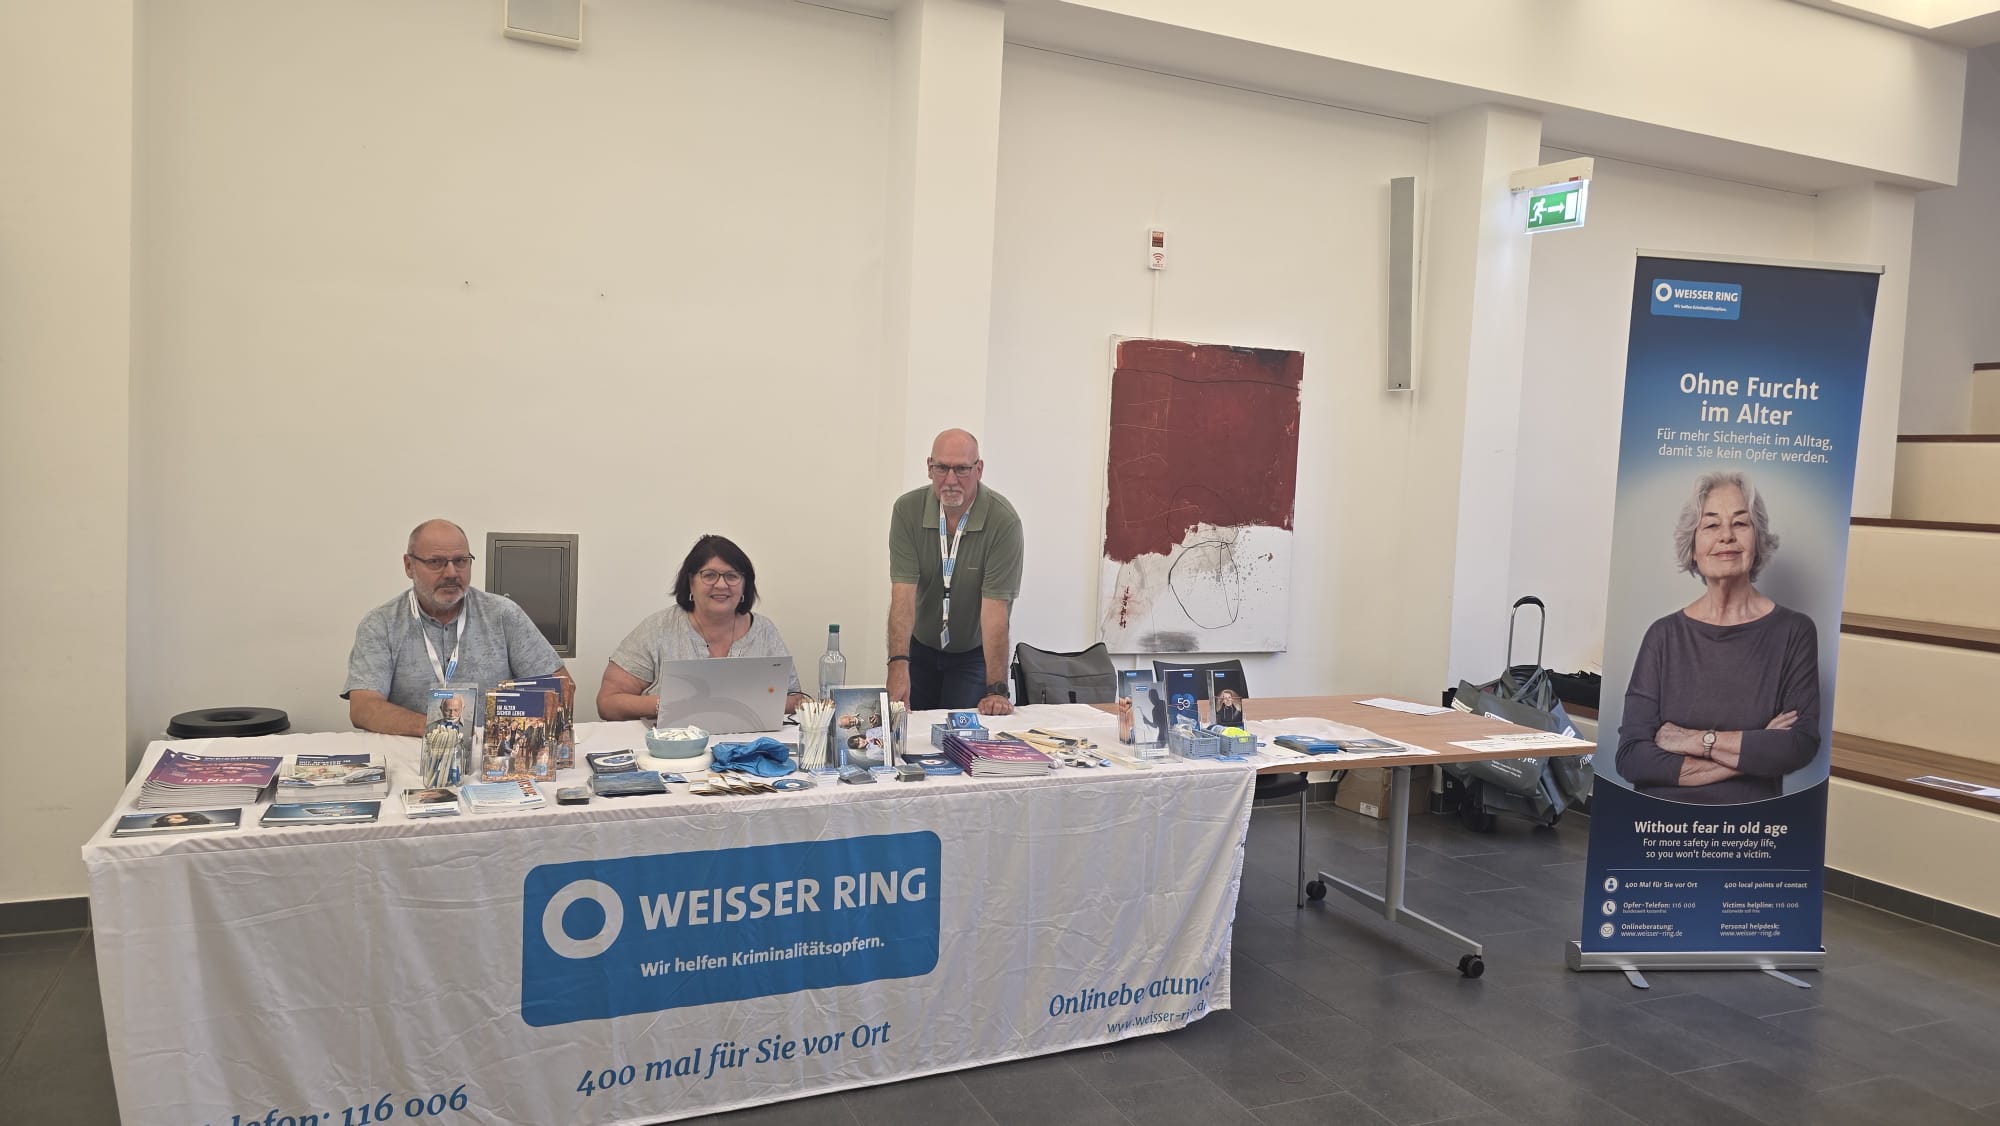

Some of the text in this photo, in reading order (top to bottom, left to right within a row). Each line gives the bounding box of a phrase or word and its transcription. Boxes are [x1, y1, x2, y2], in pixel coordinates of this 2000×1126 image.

[1674, 288, 1738, 302] WEISSER RING
[1680, 372, 1819, 400] Ohne Furcht
[1701, 400, 1793, 426] im Alter
[1657, 428, 1833, 451] Für mehr Sicherheit im Alltag,
[1658, 443, 1828, 464] damit Sie kein Opfer werden.
[1177, 698, 1190, 710] 50
[1634, 821, 1788, 837] Without fear in old age
[1643, 838, 1777, 849] For more safety in everyday life,
[1658, 851, 1673, 860] you
[1675, 850, 1699, 858] won't
[1701, 850, 1734, 859] become
[1743, 850, 1771, 859] victim.
[1754, 881, 1774, 889] points
[639, 867, 926, 931] WEISSER RING
[1621, 923, 1673, 931] Onlineberatung:
[640, 936, 885, 978] Wir helfen Kriminalitätsopfern.
[576, 1021, 891, 1096] 400 mal für Sie vor Ort
[341, 1092, 394, 1126] 116
[405, 1084, 467, 1117] 006
